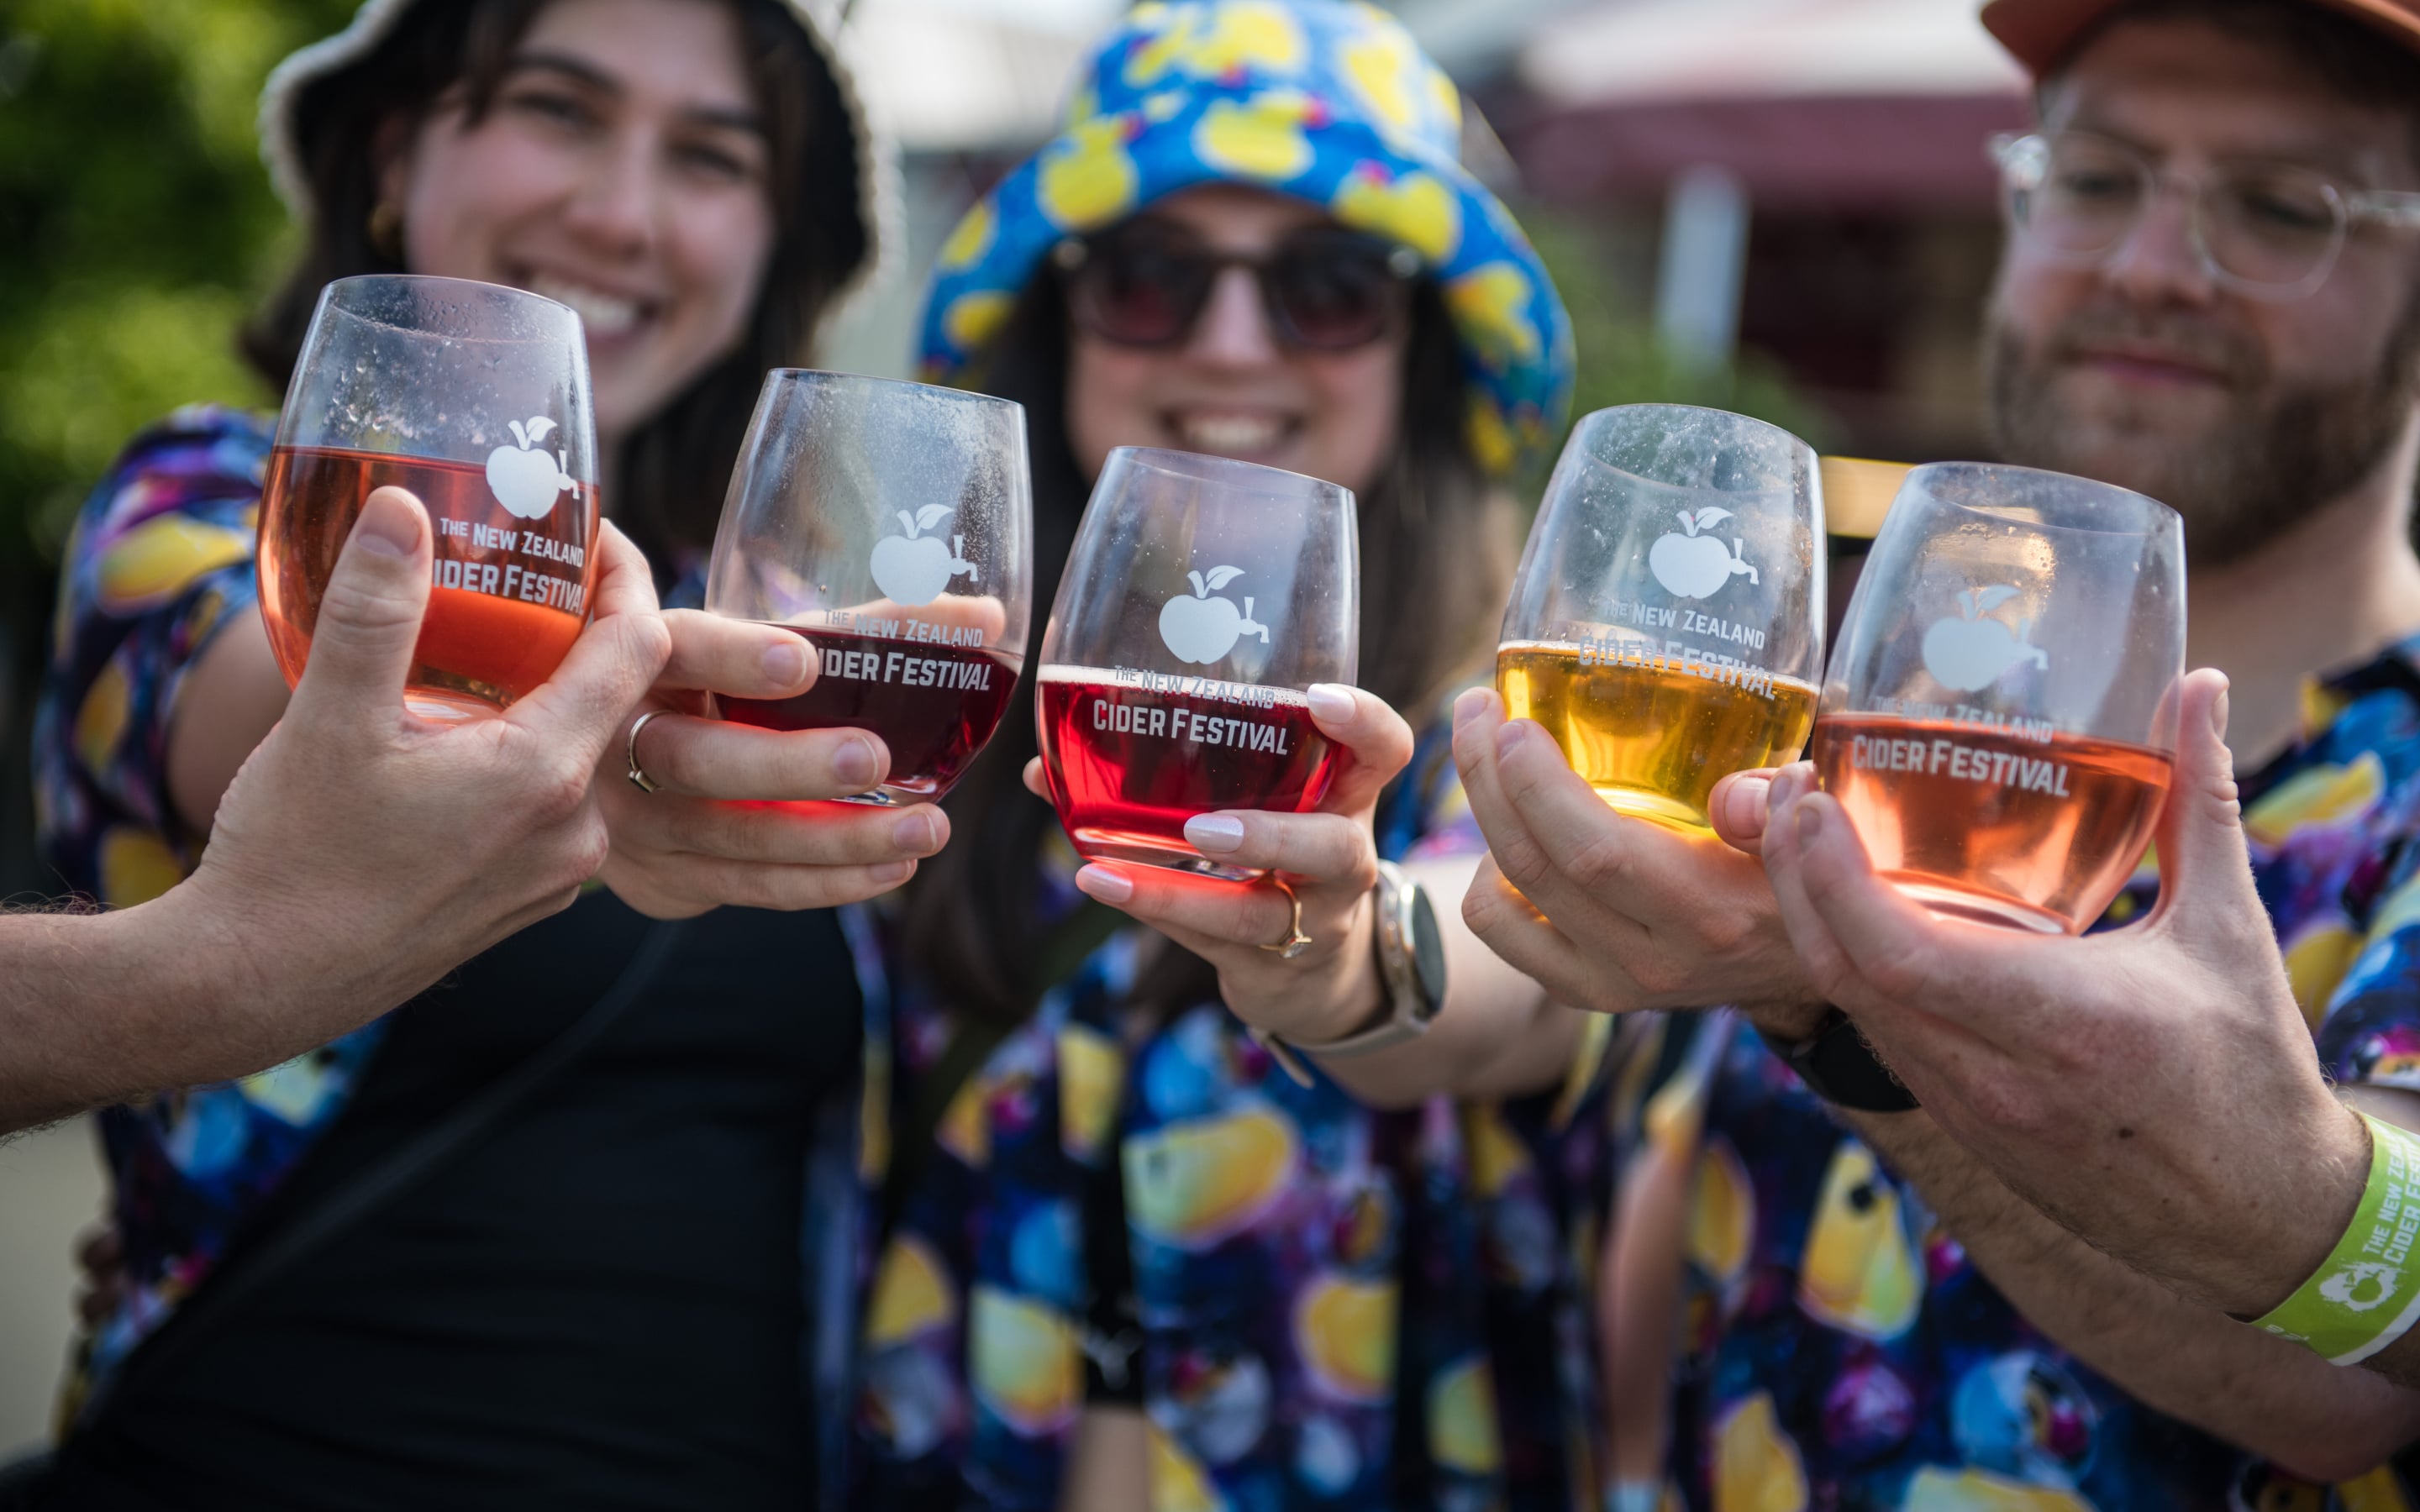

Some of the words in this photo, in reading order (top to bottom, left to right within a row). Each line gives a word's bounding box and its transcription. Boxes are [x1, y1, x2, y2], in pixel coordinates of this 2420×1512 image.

[440, 517, 469, 537] THE
[473, 522, 517, 551] NEW
[521, 531, 584, 568] ZEALAND
[433, 559, 499, 595] IDER
[502, 564, 587, 616] FESTIVAL
[824, 607, 850, 626] THE
[854, 613, 900, 639] NEW
[904, 618, 983, 648] ZEALAND
[1602, 600, 1628, 617] THE
[1632, 602, 1677, 628] NEW
[1681, 609, 1765, 650] ZEALAND
[818, 648, 880, 681] IDER
[883, 652, 991, 690] FESTIVAL
[1114, 665, 1139, 682] THE
[1142, 669, 1184, 695] NEW
[1190, 675, 1275, 709] ZEALAND
[1579, 635, 1657, 669] CIDER
[1663, 640, 1776, 701] FESTIVAL
[1093, 699, 1166, 737] CIDER
[1171, 707, 1288, 756] FESTIVAL
[1902, 698, 1948, 724] NEW
[1954, 703, 2054, 744] ZEALAND
[1852, 734, 1926, 773] CIDER
[1930, 739, 2070, 797] FESTIVAL
[2362, 1224, 2391, 1254] THE
[2378, 1182, 2403, 1223] NEW
[2383, 1205, 2420, 1265] CIDER
